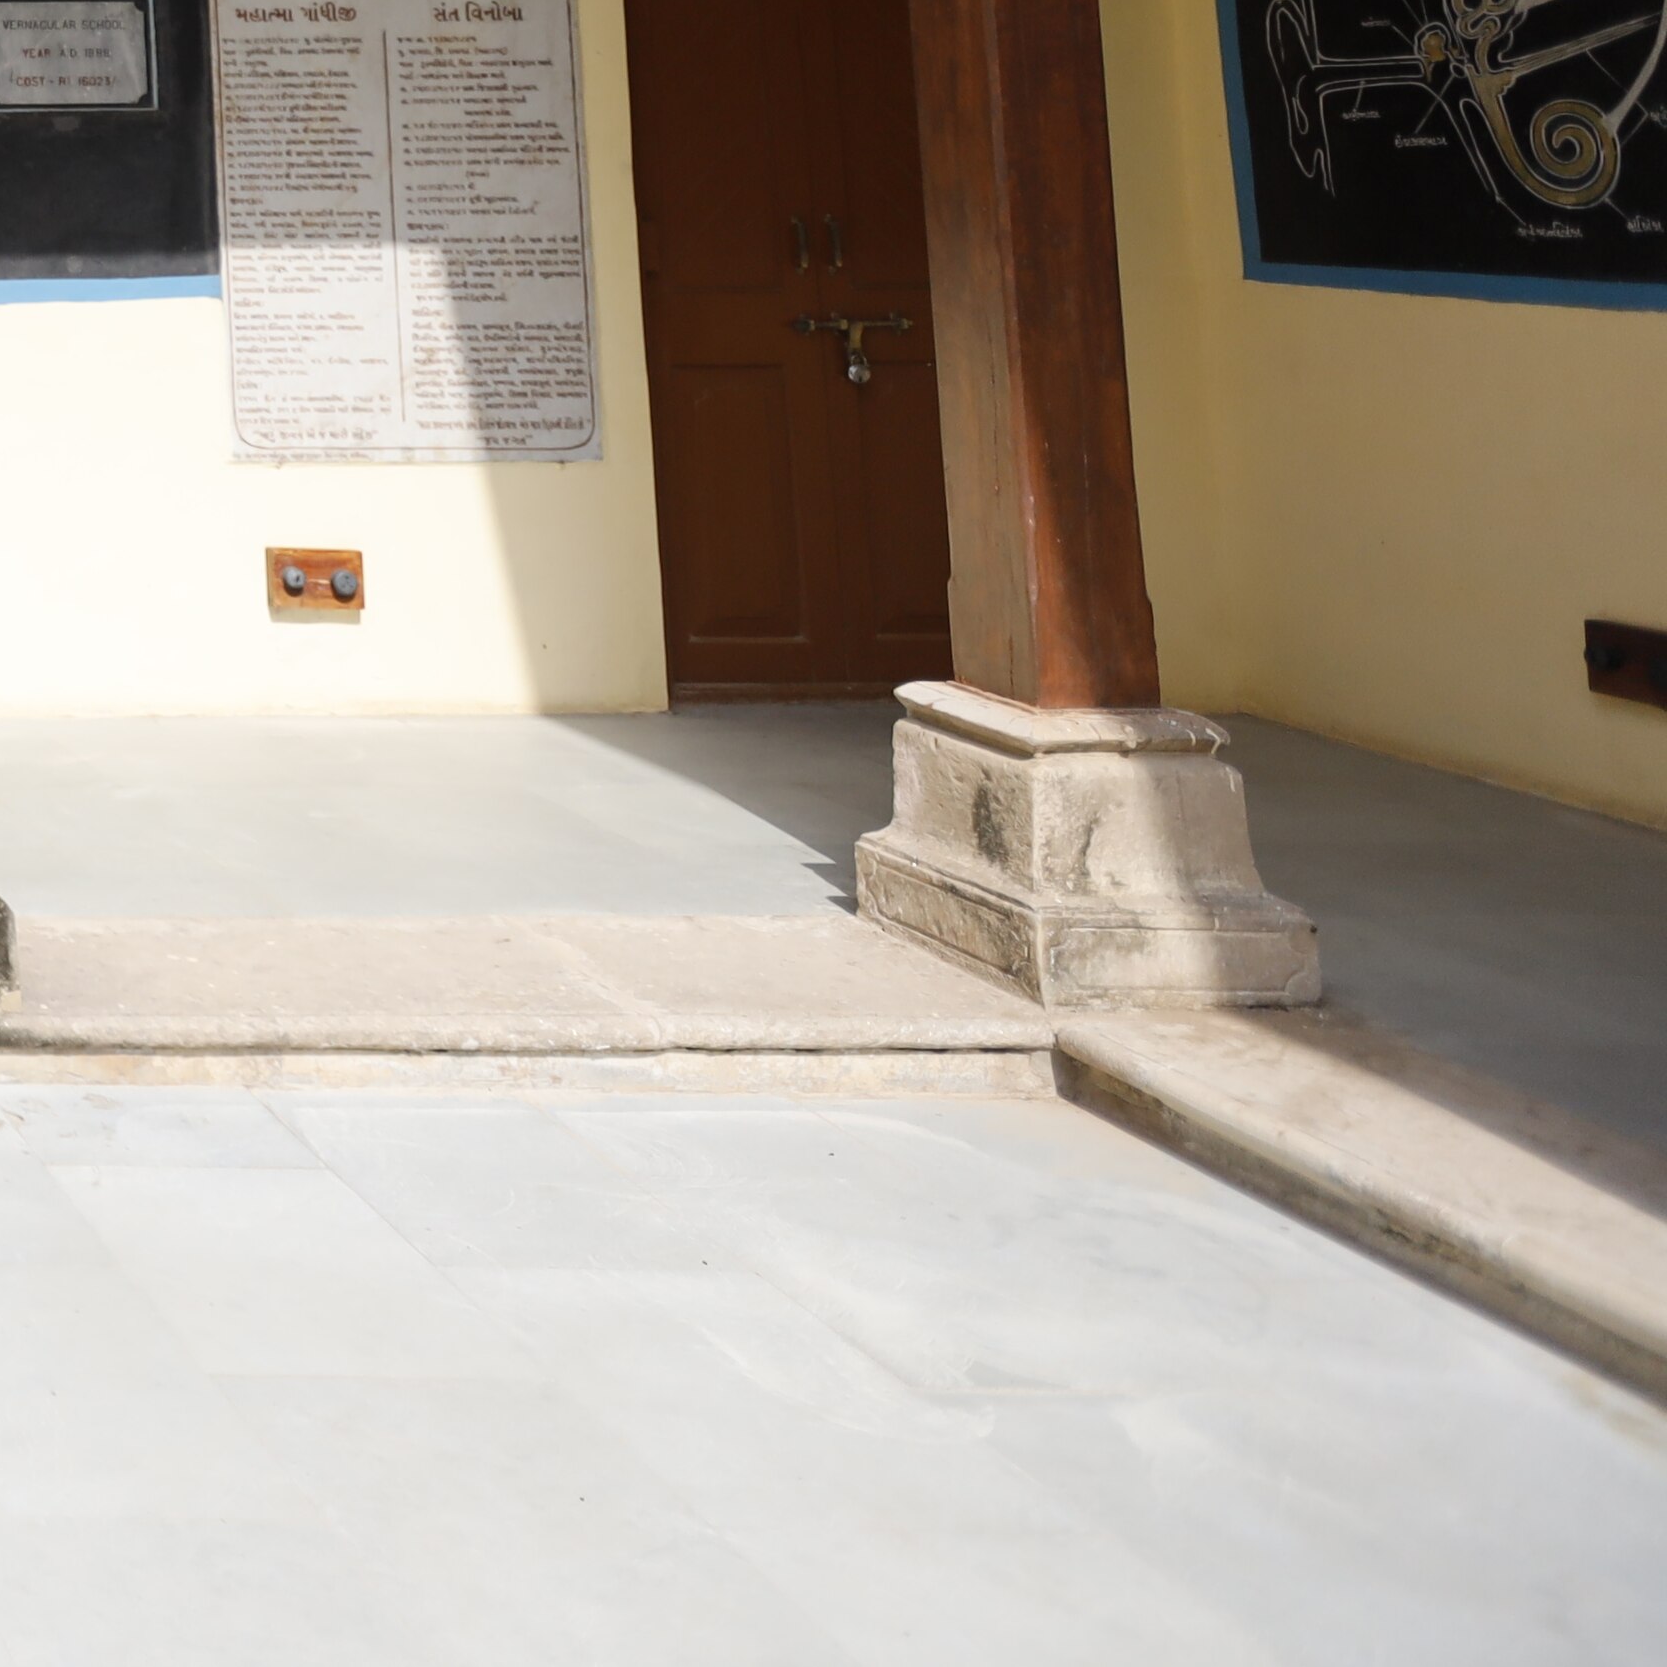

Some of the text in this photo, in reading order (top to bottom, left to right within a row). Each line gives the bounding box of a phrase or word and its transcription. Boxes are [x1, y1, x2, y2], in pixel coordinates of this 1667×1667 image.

[234, 1, 358, 24] મહાત્મા ગાંધીજી
[432, 0, 524, 23] સંત વિનોબા
[2, 19, 126, 31] VERNACULAR SCHOOL
[22, 48, 51, 59] YEAR
[15, 76, 46, 88] COST
